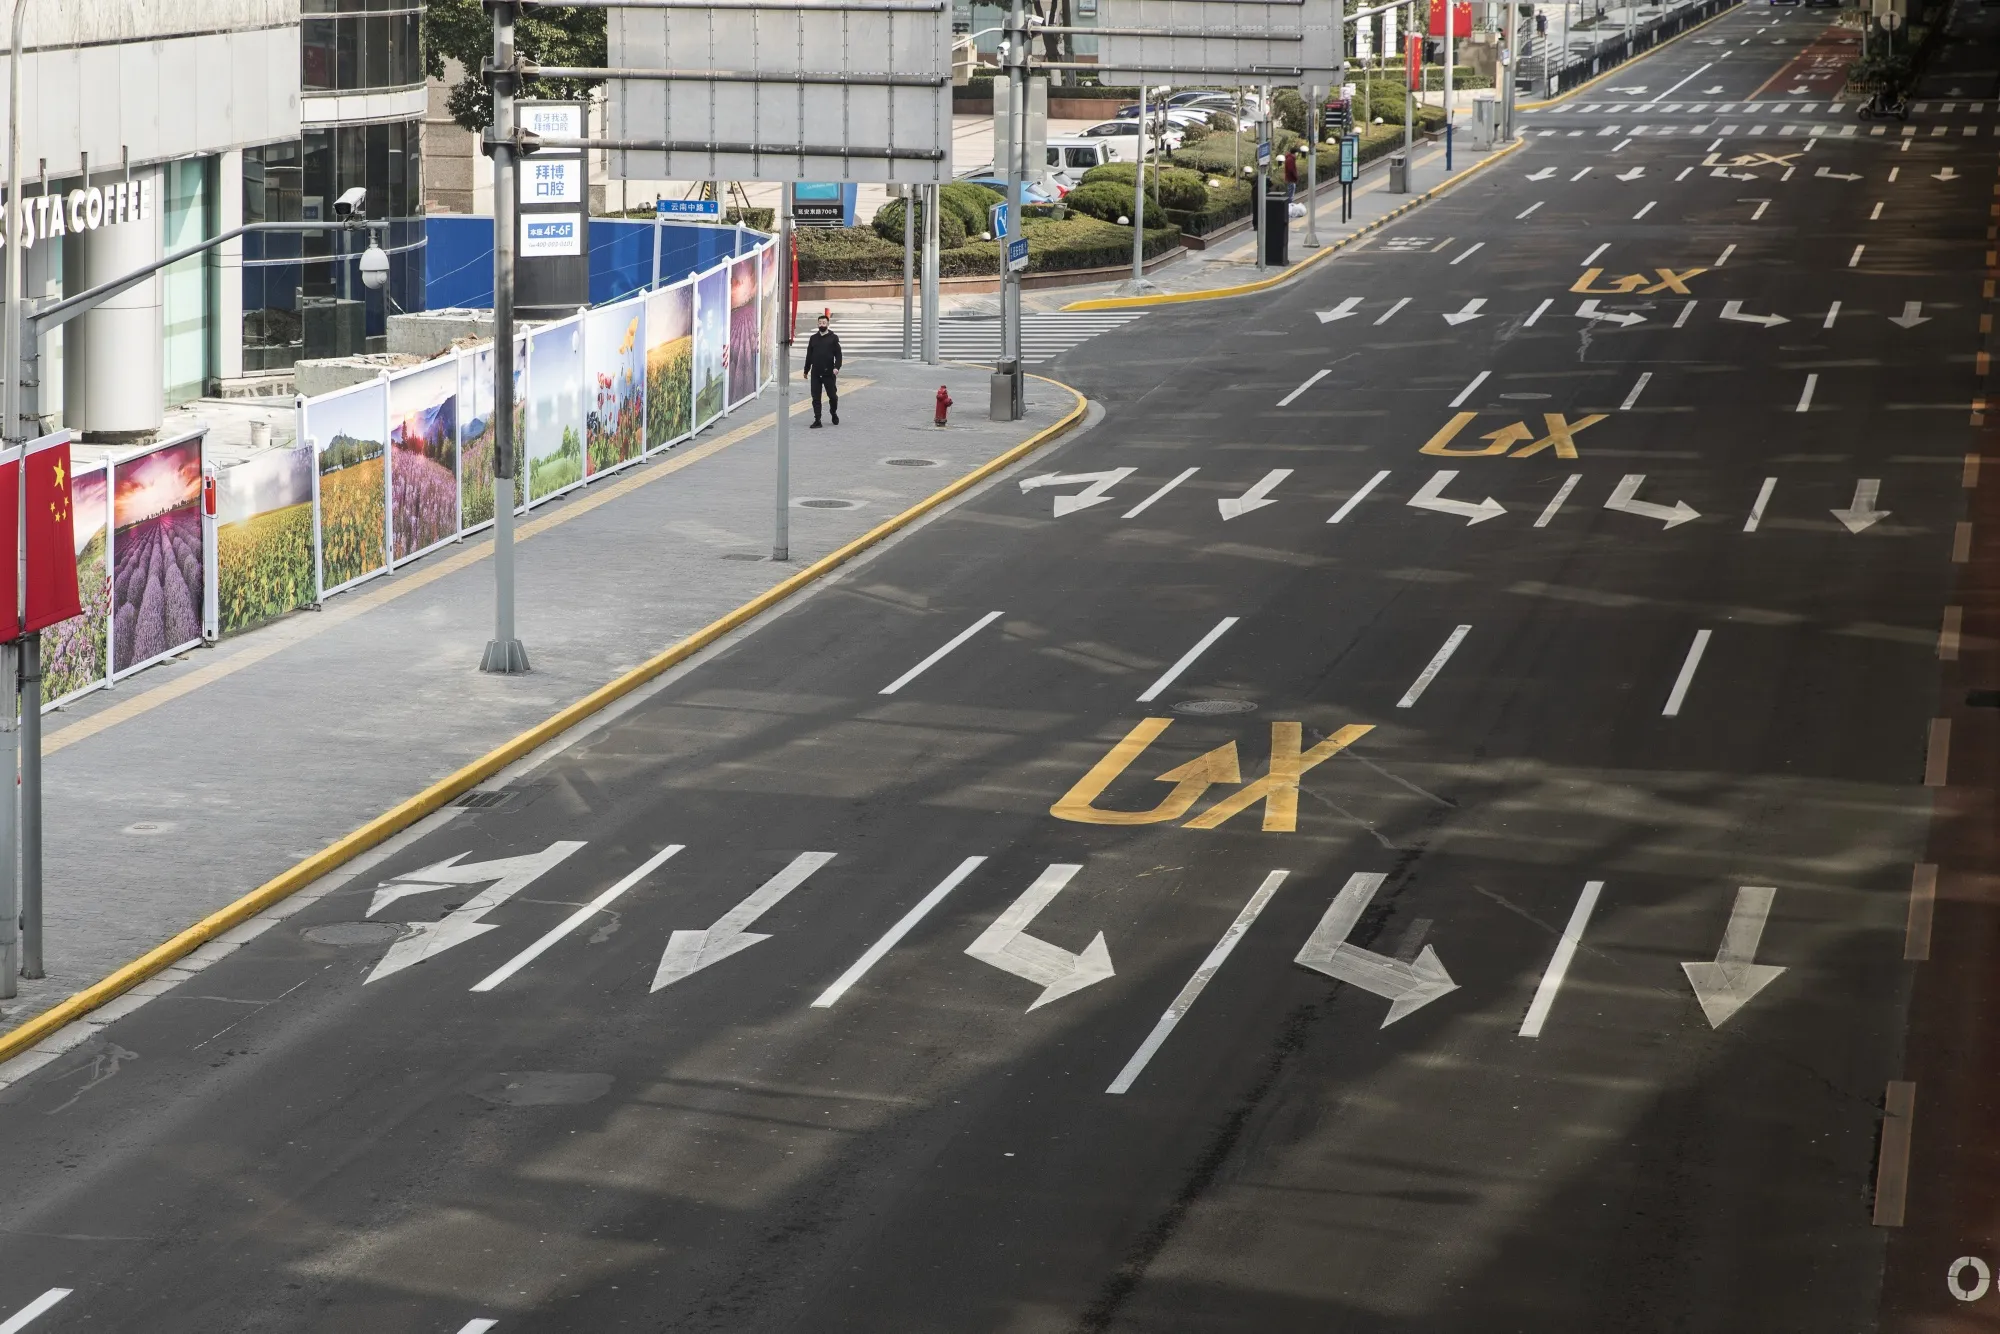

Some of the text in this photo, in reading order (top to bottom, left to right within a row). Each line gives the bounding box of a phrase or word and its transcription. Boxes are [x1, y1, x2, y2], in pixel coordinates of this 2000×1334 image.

[534, 123, 569, 132] 拜博口腔
[536, 165, 564, 180] 拜博
[536, 181, 564, 196] 口腔
[671, 202, 704, 212] 云南中路
[0, 179, 152, 249] STA COFFEE
[543, 225, 571, 236] 4F-6F
